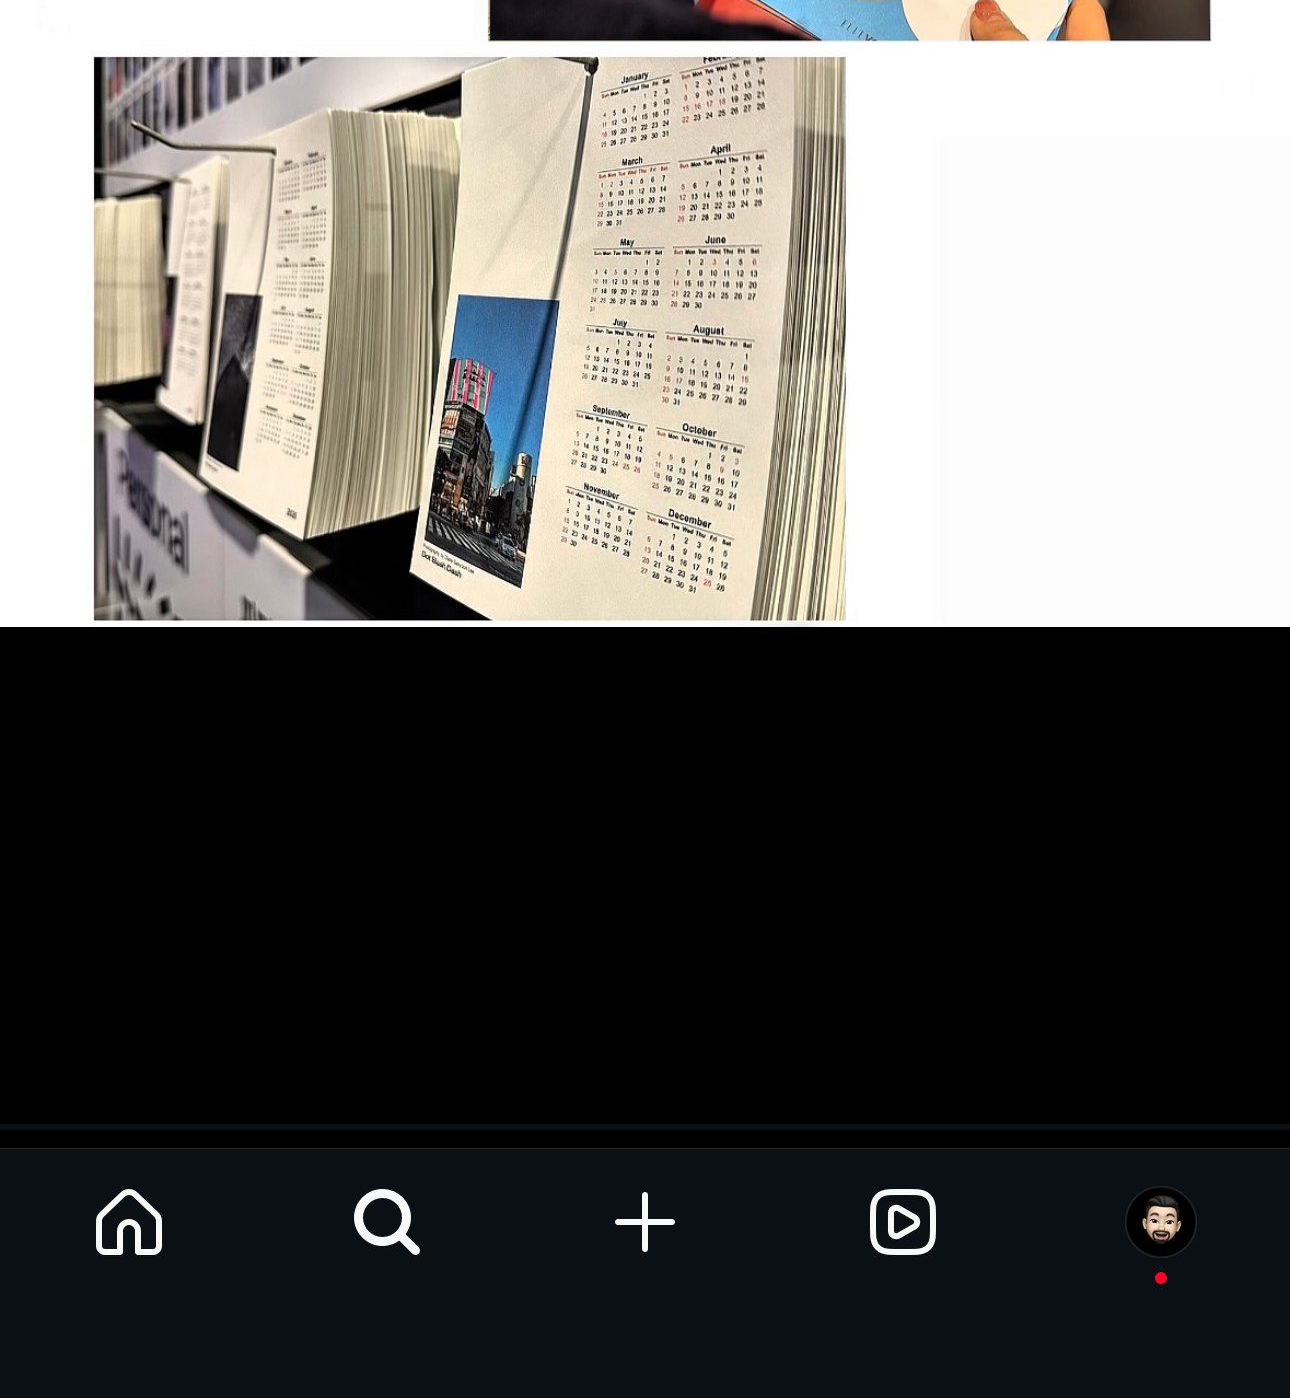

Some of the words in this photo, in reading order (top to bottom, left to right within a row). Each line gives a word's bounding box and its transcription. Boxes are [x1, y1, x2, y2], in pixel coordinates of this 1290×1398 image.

[621, 72, 649, 84] January
[710, 143, 731, 157] April
[622, 156, 643, 166] March
[620, 238, 635, 247] May
[705, 235, 726, 244] June
[613, 318, 627, 328] July
[693, 324, 724, 336] August
[593, 405, 630, 419] September
[682, 423, 717, 437] October
[679, 467, 686, 475] 13
[692, 470, 698, 478] 14
[584, 483, 619, 500] November
[668, 509, 712, 529] December
